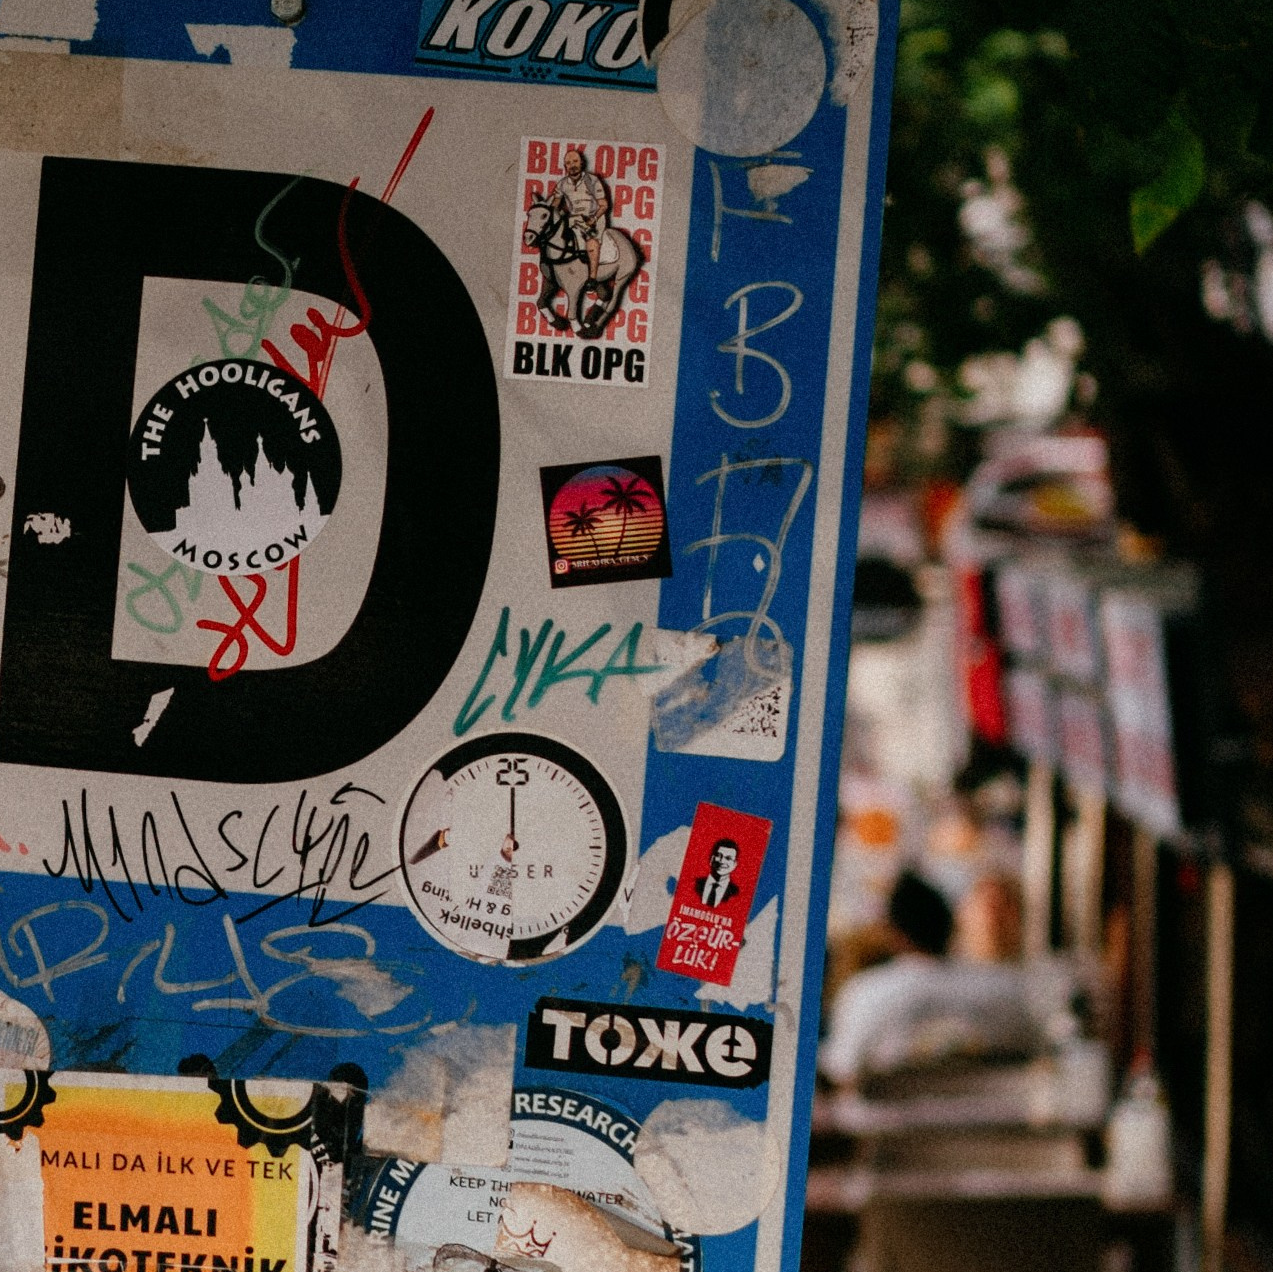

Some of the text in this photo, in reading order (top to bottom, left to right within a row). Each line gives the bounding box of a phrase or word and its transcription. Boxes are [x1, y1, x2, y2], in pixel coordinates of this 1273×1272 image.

[594, 144, 659, 182] OPG
[513, 341, 645, 383] BLK OPG
[141, 363, 321, 461] THE HOOLIGANS
[172, 524, 309, 571] MOSCOW
[496, 758, 529, 785] 25
[41, 1150, 293, 1180] MALI DA İLK VE TEK
[370, 1185, 400, 1244] RINE
[514, 1093, 640, 1155] RESEARCH
[450, 1177, 485, 1189] KEEP
[568, 1189, 624, 1206] WATER
[73, 1201, 217, 1237] ELMALI
[467, 1210, 493, 1223] LET
